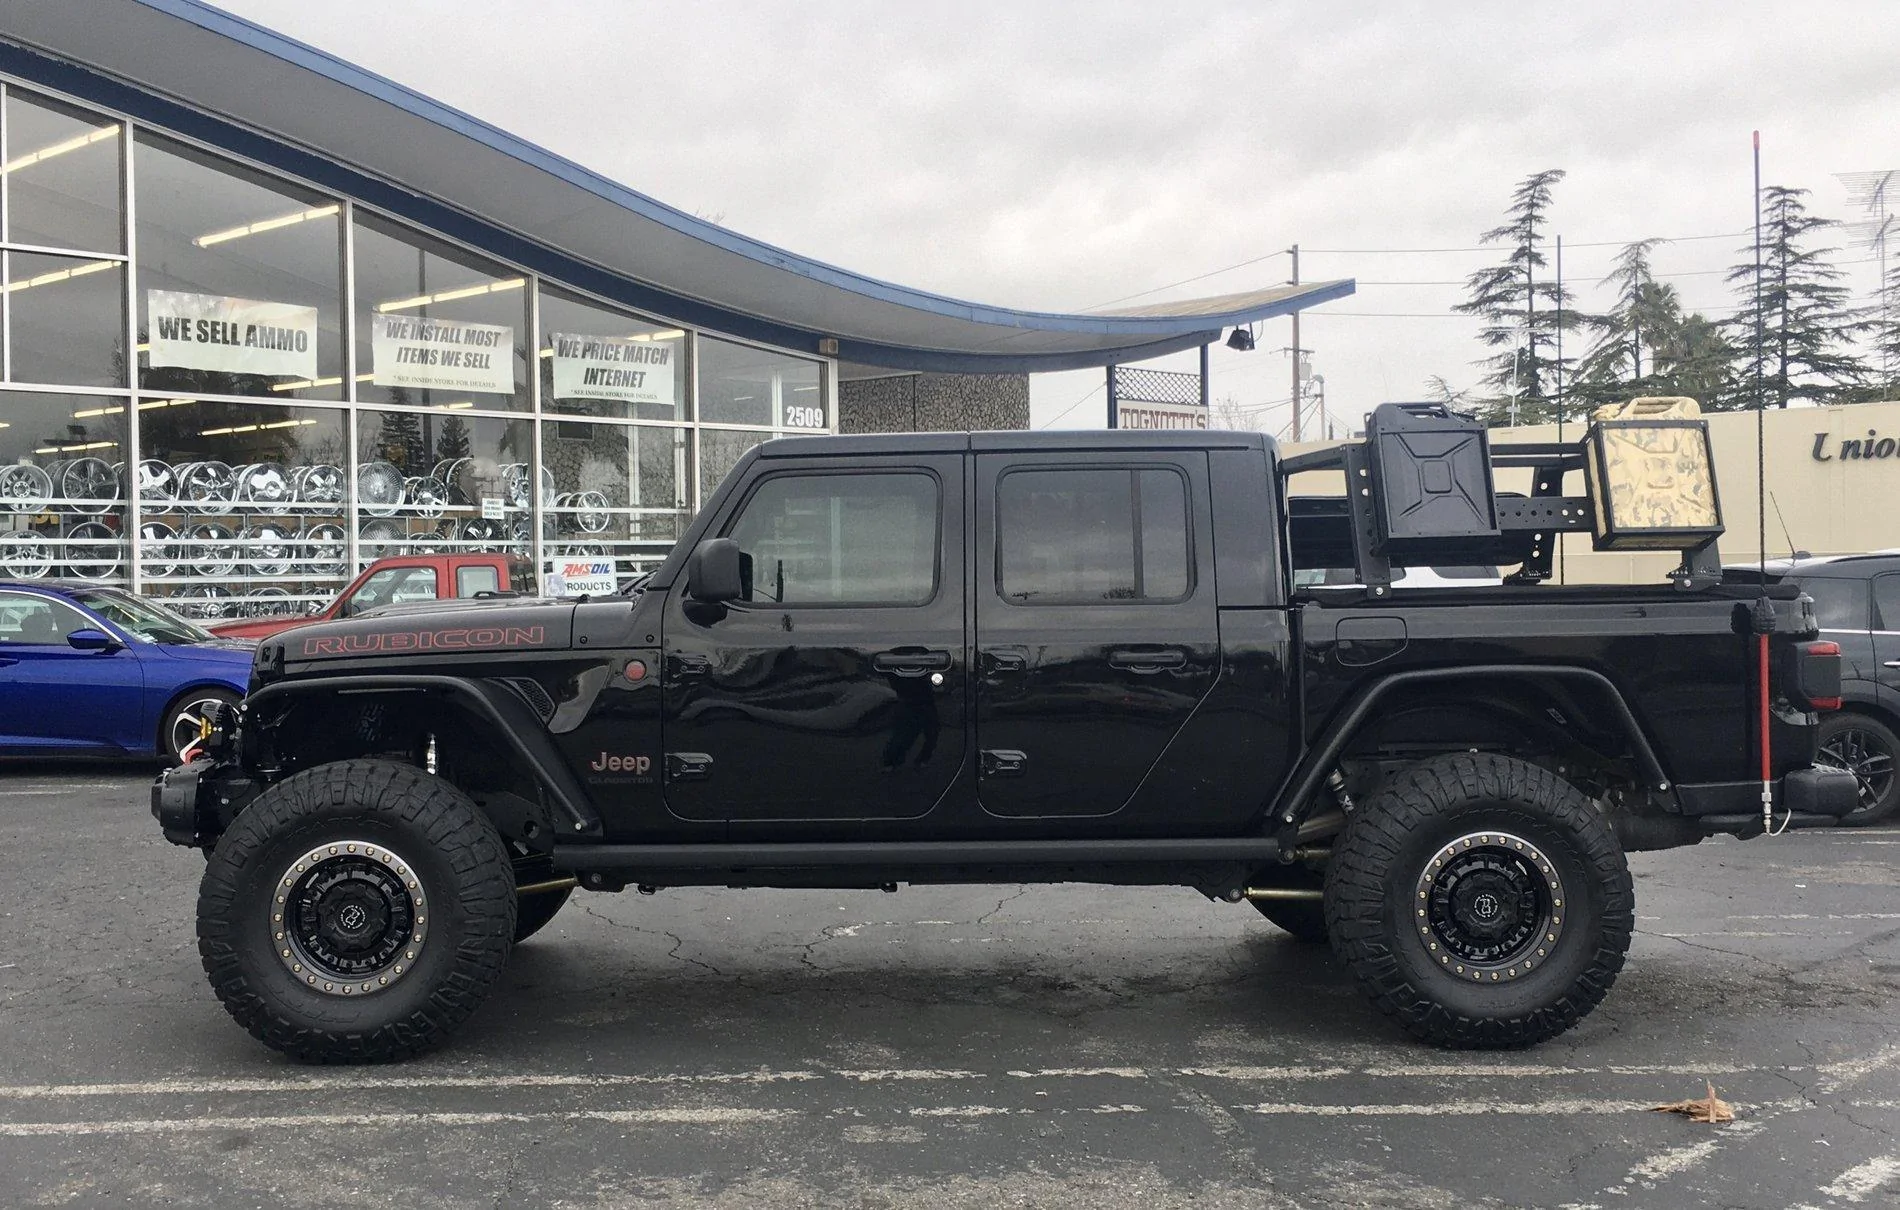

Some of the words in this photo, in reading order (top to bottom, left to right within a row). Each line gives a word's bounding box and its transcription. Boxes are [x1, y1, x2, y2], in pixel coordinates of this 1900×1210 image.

[157, 315, 191, 341] WE
[196, 319, 241, 346] SELL
[245, 324, 308, 353] AMMO
[386, 321, 408, 340] WE
[410, 324, 461, 344] INSTALL
[464, 329, 501, 348] MOST
[396, 347, 438, 366] ITEMS
[441, 350, 461, 367] WE
[463, 352, 491, 369] SELL
[558, 340, 580, 358] WE
[581, 341, 621, 361] PRICE
[623, 345, 669, 365] MATCH
[583, 367, 646, 388] INTERNET
[786, 405, 823, 428] 2509
[1812, 429, 1900, 462] Unio
[561, 563, 611, 578] AMSOIL
[565, 581, 612, 591] RODUCTS
[304, 626, 544, 655] RUBICON
[592, 751, 651, 775] Jeep
